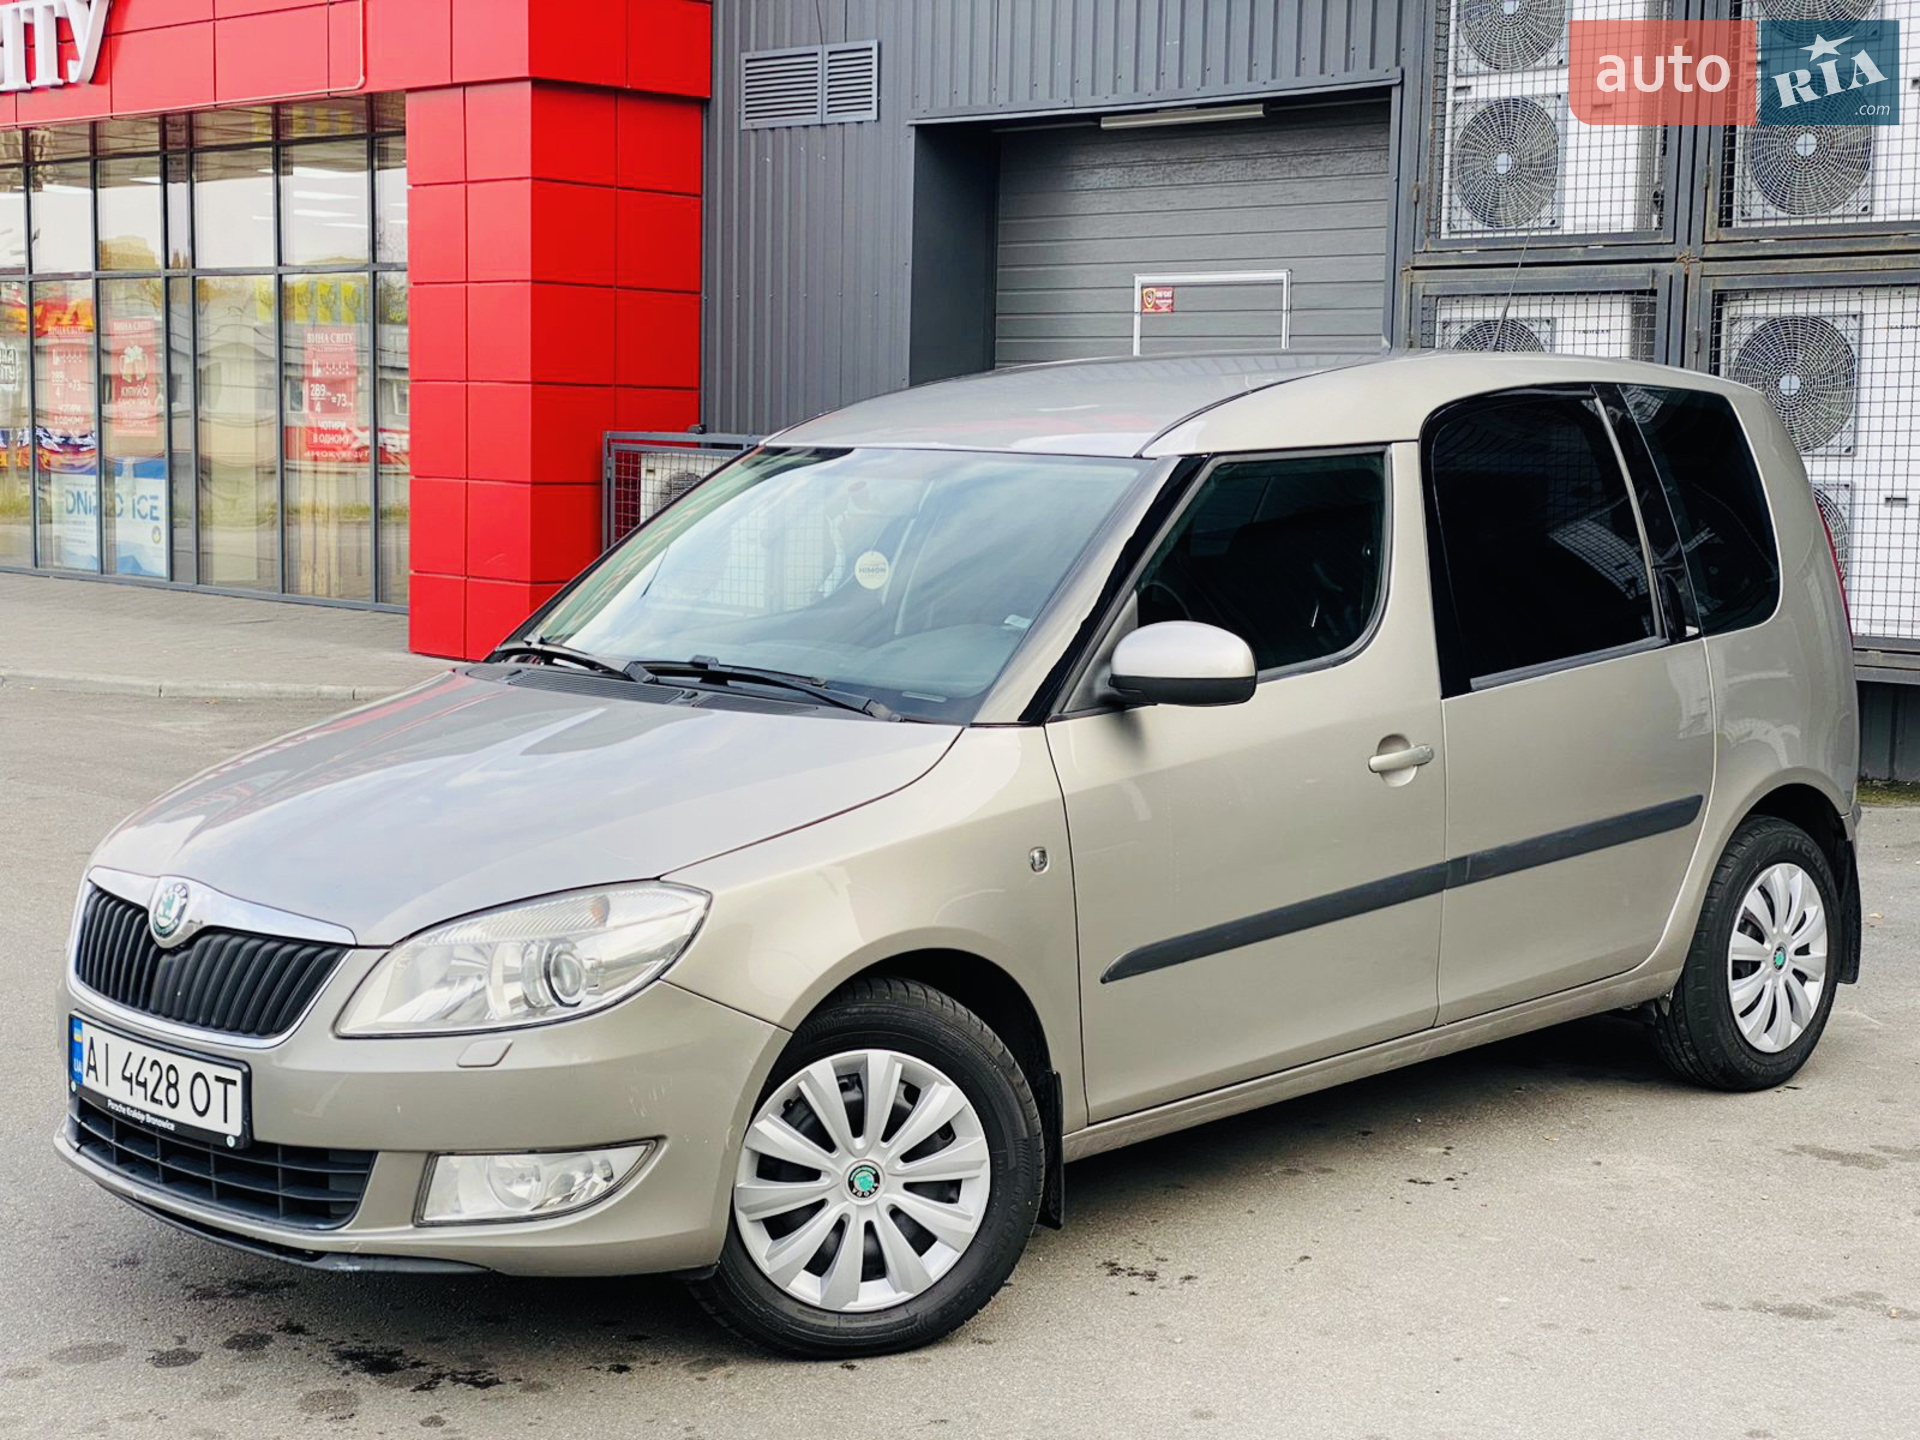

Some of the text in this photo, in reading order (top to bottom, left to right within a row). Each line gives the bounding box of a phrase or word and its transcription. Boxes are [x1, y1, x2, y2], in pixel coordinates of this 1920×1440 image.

[310, 383, 326, 397] 289
[315, 401, 321, 413] 4
[132, 494, 159, 522] ICE
[86, 1036, 237, 1124] AI 4428 OT
